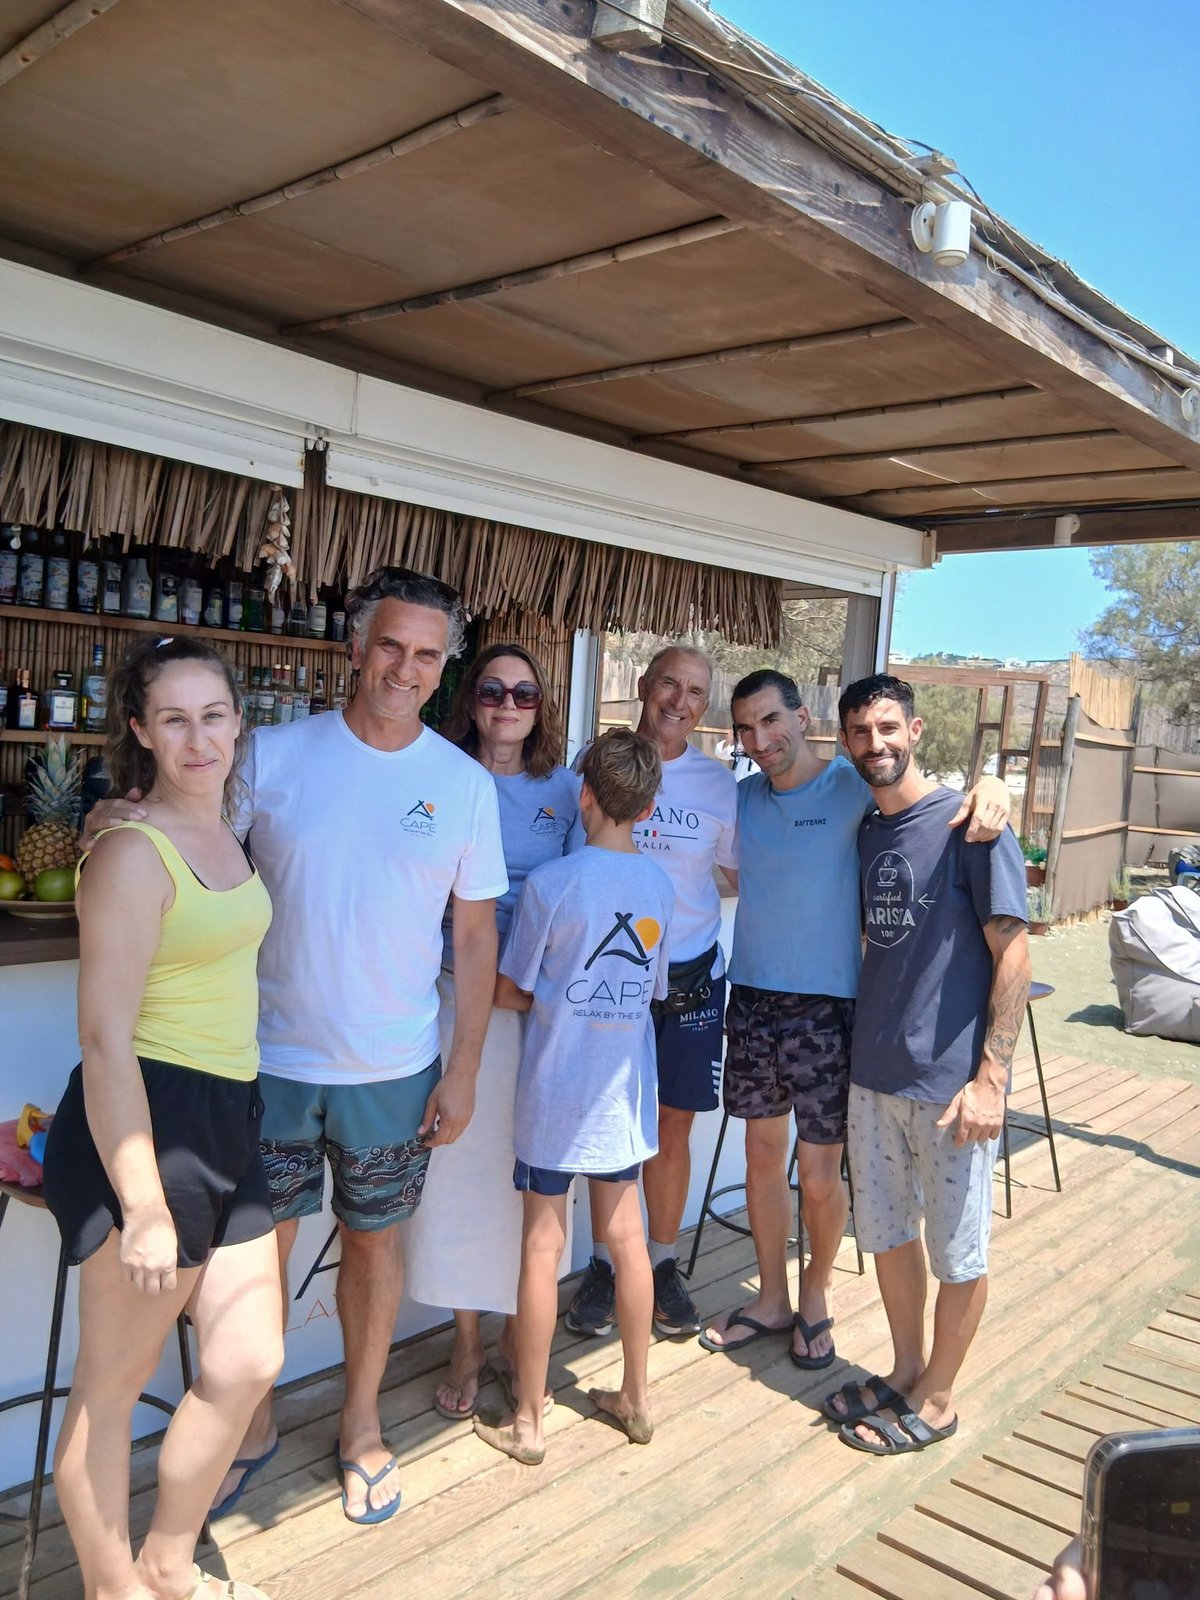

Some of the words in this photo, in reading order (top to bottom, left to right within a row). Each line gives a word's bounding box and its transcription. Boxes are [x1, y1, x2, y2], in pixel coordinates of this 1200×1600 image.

[649, 806, 699, 829] ANO
[400, 817, 437, 833] CAPE
[530, 822, 558, 832] CAPE
[635, 841, 671, 851] TALIA
[873, 891, 902, 905] certified
[866, 907, 916, 926] ARISTA
[566, 979, 653, 1005] CAPE
[573, 1009, 602, 1018] RELAX
[603, 1011, 616, 1019] BY
[617, 1012, 634, 1020] THE
[680, 1008, 719, 1022] MILANO
